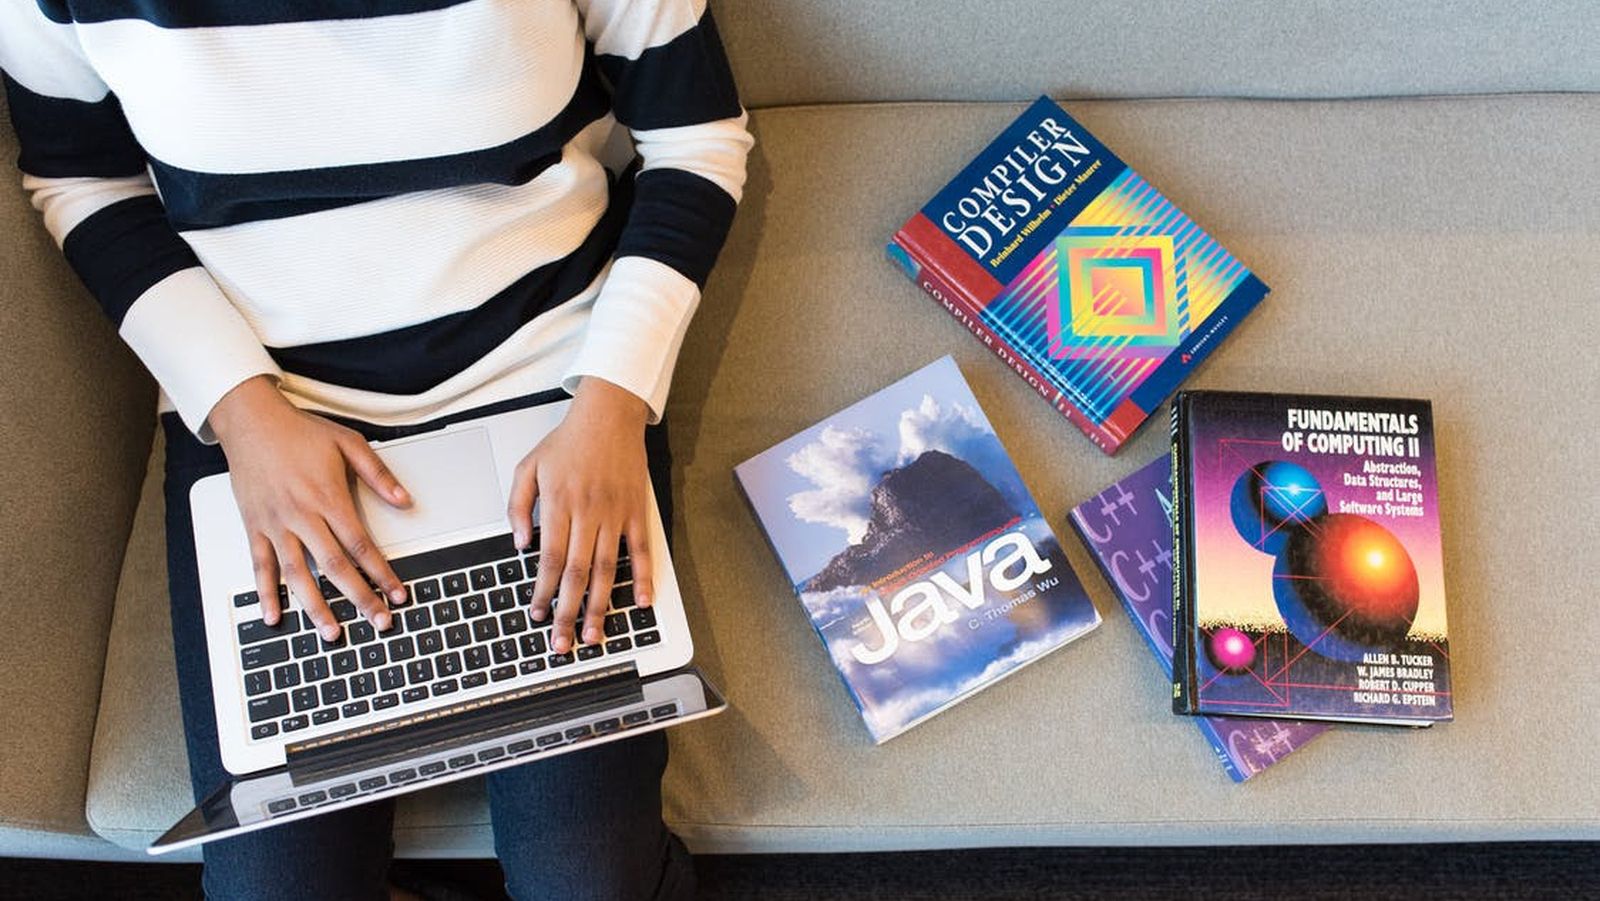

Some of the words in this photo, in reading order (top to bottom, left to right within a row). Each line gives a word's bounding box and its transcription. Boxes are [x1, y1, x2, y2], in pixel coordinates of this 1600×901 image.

[943, 118, 1066, 233] COMPILER
[958, 131, 1090, 259] DESIGN
[990, 235, 1024, 267] Reinhard
[1021, 209, 1052, 237] Wilhelm
[1053, 183, 1077, 206] Dieter
[1074, 160, 1102, 184] Maurer
[922, 281, 992, 345] COMPILER
[997, 348, 1049, 396] DESIGN
[1288, 409, 1419, 434] FUNDAMENTALS
[1282, 432, 1303, 452] OF
[1307, 433, 1404, 457] COMPUTING
[1408, 437, 1420, 457] II
[1363, 460, 1421, 477] Abstraction,
[1344, 473, 1367, 486] Data
[1369, 475, 1422, 490] Structures,
[1376, 490, 1393, 501] and
[1395, 490, 1422, 505] Large
[1340, 501, 1382, 515] Software
[1384, 503, 1424, 518] Systems
[851, 532, 1053, 665] Java
[968, 618, 984, 630] C.
[984, 591, 1036, 621] Thomas
[1036, 577, 1059, 592] Wu
[1363, 653, 1389, 664] ALLEN
[1401, 654, 1433, 666] TUCKER
[1356, 666, 1368, 676] W.
[1369, 666, 1395, 679] JAMES
[1396, 668, 1434, 680] BRADLEY
[1359, 679, 1390, 691] ROBERT
[1392, 681, 1400, 691] D.
[1402, 681, 1435, 693] CUPPER
[1353, 692, 1390, 704] RICHARD
[1403, 694, 1436, 706] EPSTEIN
